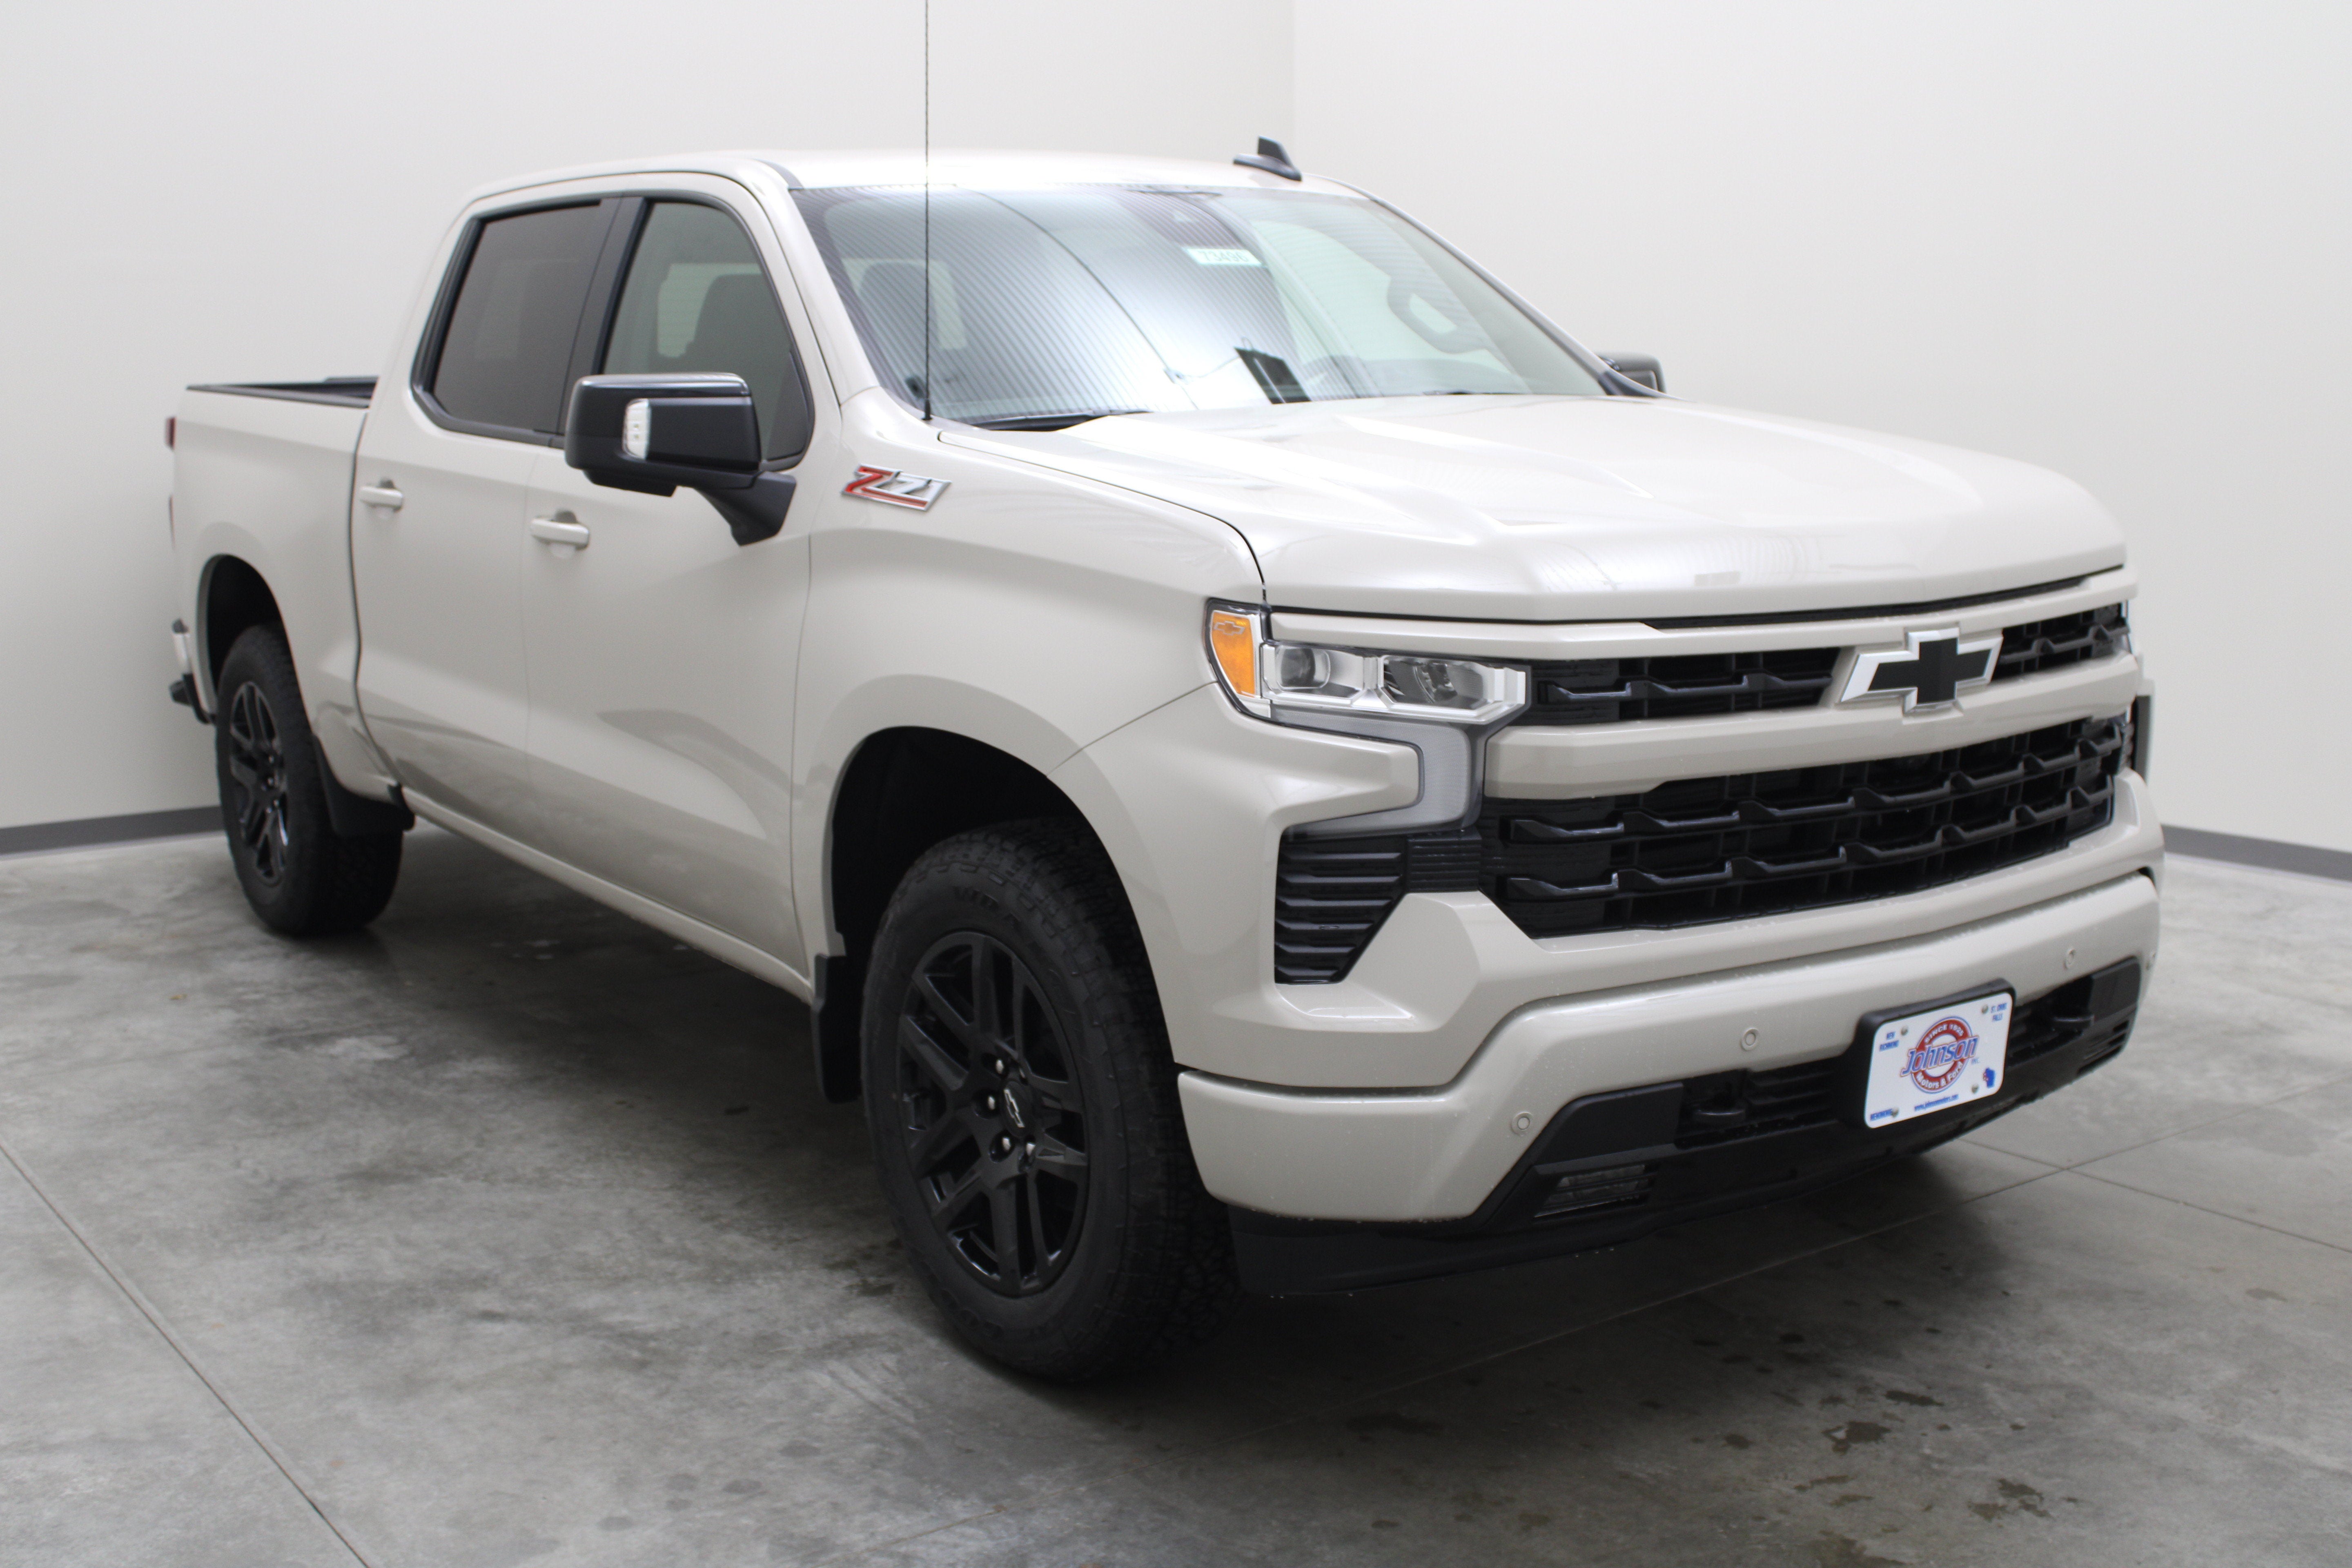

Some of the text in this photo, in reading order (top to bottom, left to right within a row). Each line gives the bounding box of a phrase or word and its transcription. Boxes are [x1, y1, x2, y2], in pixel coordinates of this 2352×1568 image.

[840, 463, 952, 511] Z71
[1925, 1024, 1948, 1043] SINCE
[1900, 1035, 1980, 1077] Johnson
[1916, 1071, 1940, 1088] Motors
[1940, 1078, 1947, 1087] &
